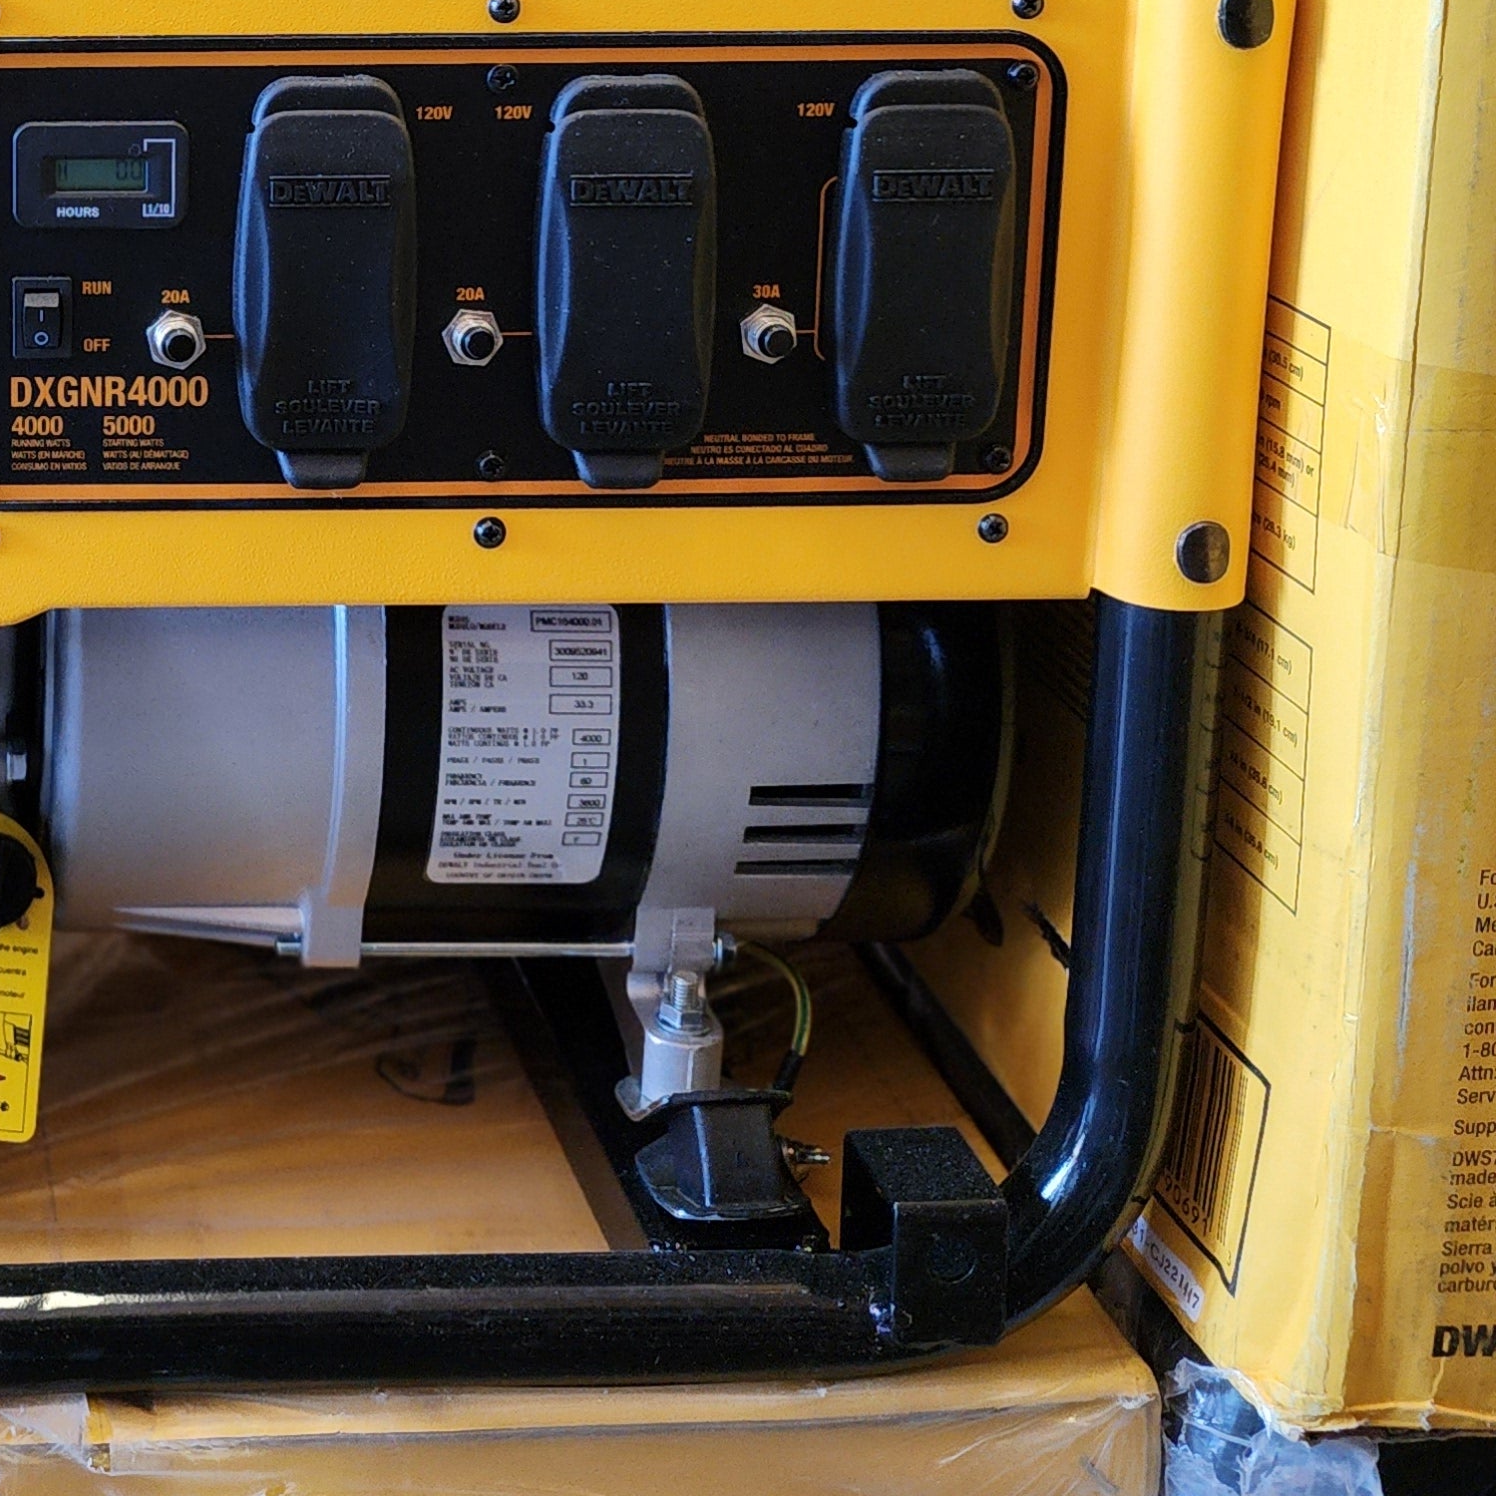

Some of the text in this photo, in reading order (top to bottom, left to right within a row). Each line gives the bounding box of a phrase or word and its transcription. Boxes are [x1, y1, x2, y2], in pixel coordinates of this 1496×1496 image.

[416, 106, 453, 121] 120V
[494, 105, 532, 120] 120V
[796, 102, 835, 118] 120V
[270, 179, 390, 203] DEWALT
[570, 177, 694, 203] DEWALT
[873, 172, 994, 199] DEWALT
[56, 206, 100, 218] HOURS
[81, 281, 112, 296] RUN
[455, 287, 485, 301] 20A
[751, 284, 781, 299] 30A
[161, 289, 191, 304] 20A
[82, 338, 111, 353] OFF
[9, 375, 209, 408] DXGNR4000
[307, 378, 352, 394] LIFT
[11, 415, 64, 436] 4000
[102, 415, 155, 436] 5000
[11, 438, 71, 448] RUNNING WATTS
[102, 438, 165, 447] STARTING WATTS
[704, 433, 739, 443] NEUTRAL
[741, 433, 775, 443] BONDED
[775, 433, 787, 443] TO
[11, 450, 37, 460] WATTS
[102, 450, 128, 460] WATTS
[690, 445, 722, 455] NEUTRO
[723, 444, 734, 454] ES
[735, 444, 783, 454] CONECTADO
[783, 443, 794, 453] AL
[11, 461, 88, 471] CONSUMO EN VATIOS
[102, 461, 128, 471] VATIOS
[129, 461, 140, 471] DE
[12, 944, 39, 956] engine
[1446, 1193, 1481, 1210] Scie
[1441, 1241, 1493, 1257] Sierra
[1439, 1260, 1485, 1278] polvo
